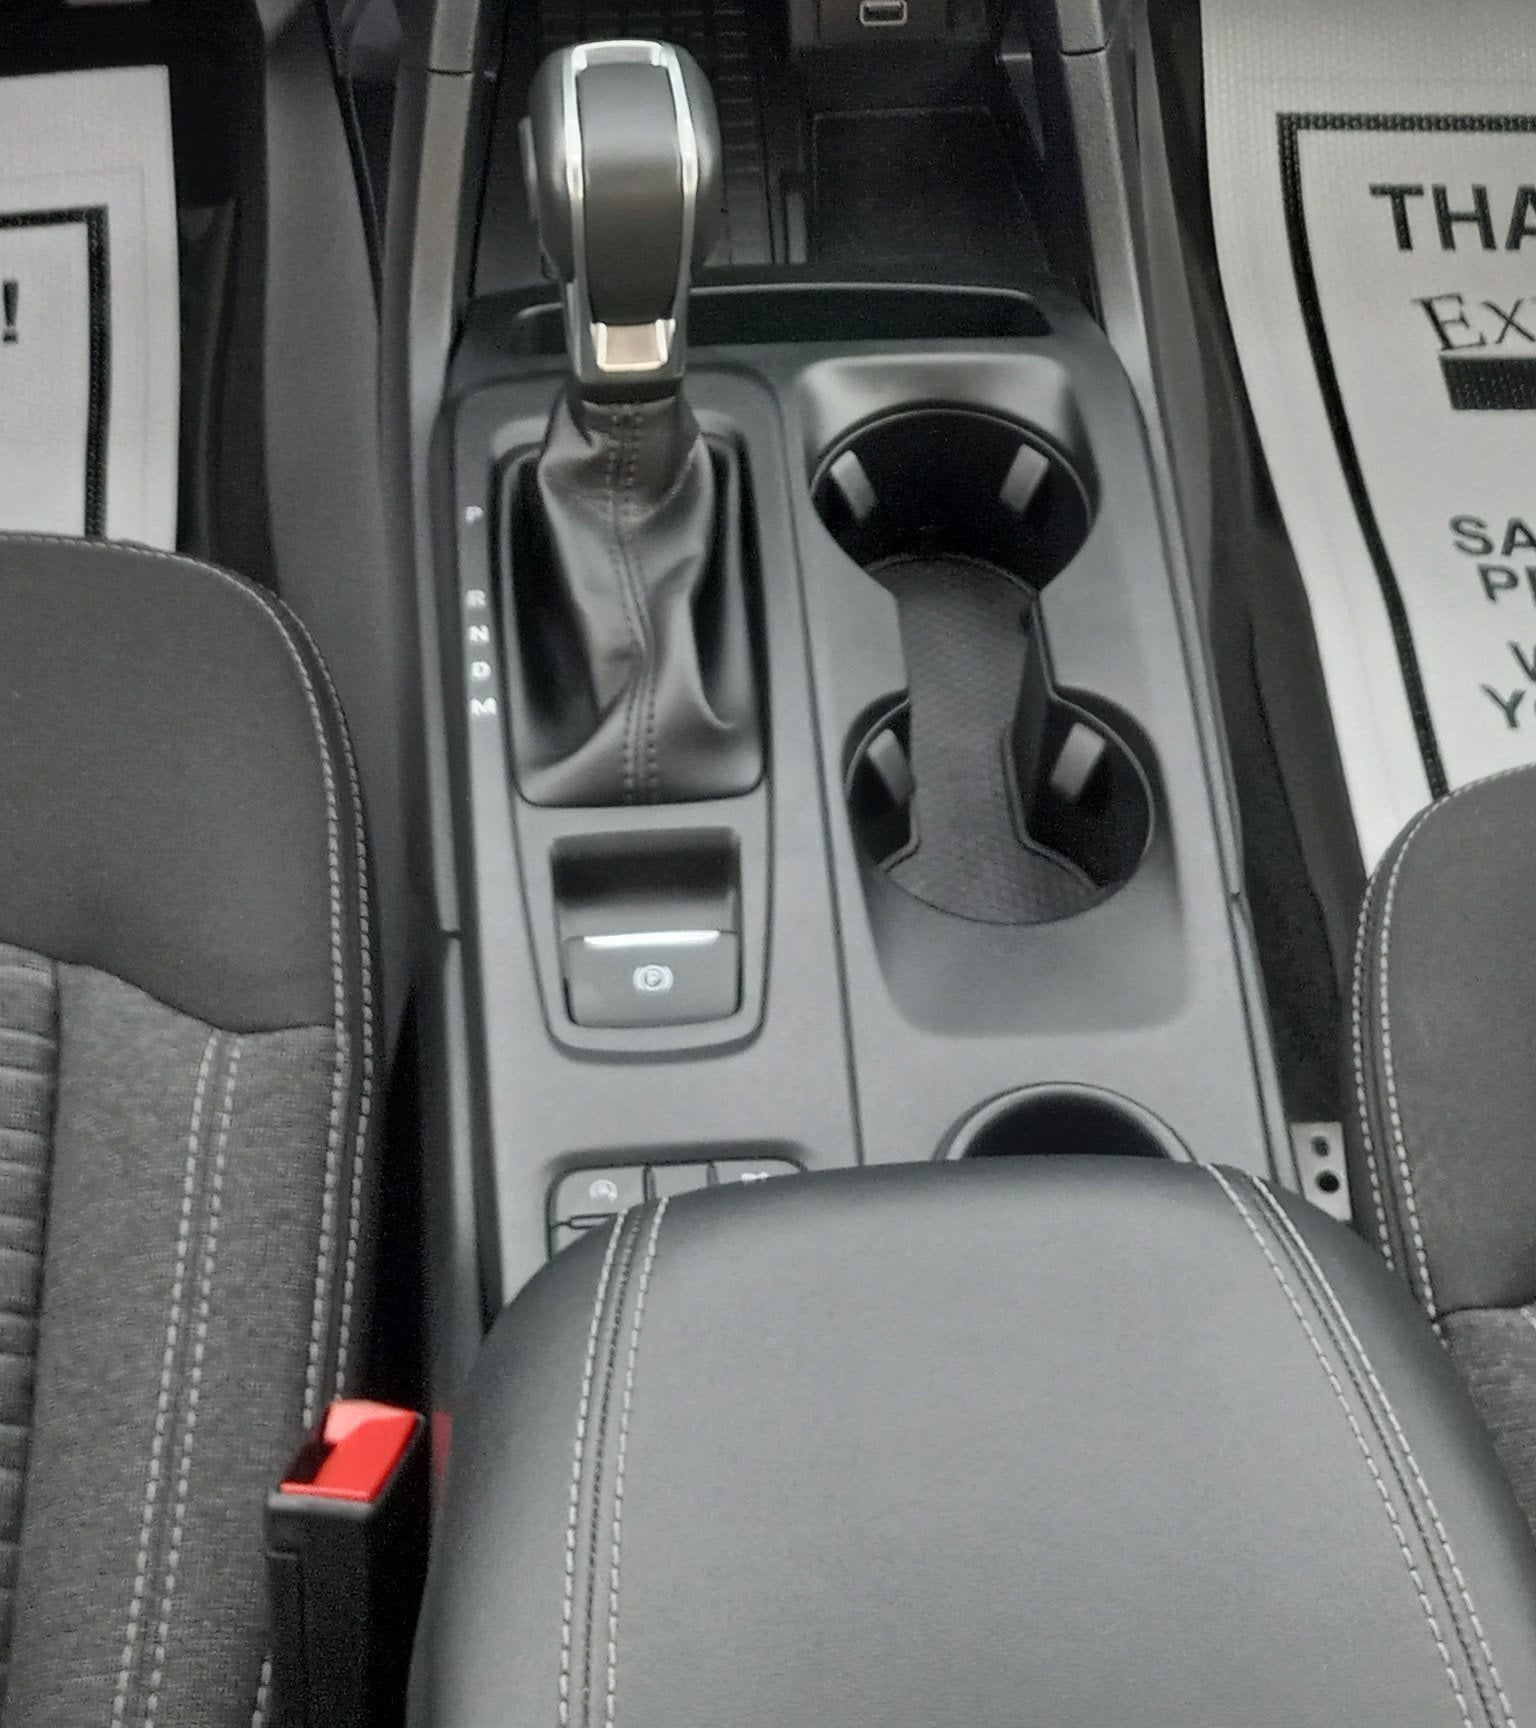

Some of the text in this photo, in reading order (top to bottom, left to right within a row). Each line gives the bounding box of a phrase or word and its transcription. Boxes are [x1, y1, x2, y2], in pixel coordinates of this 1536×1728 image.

[465, 588, 486, 608] R
[468, 624, 491, 644] N
[470, 696, 498, 716] M
